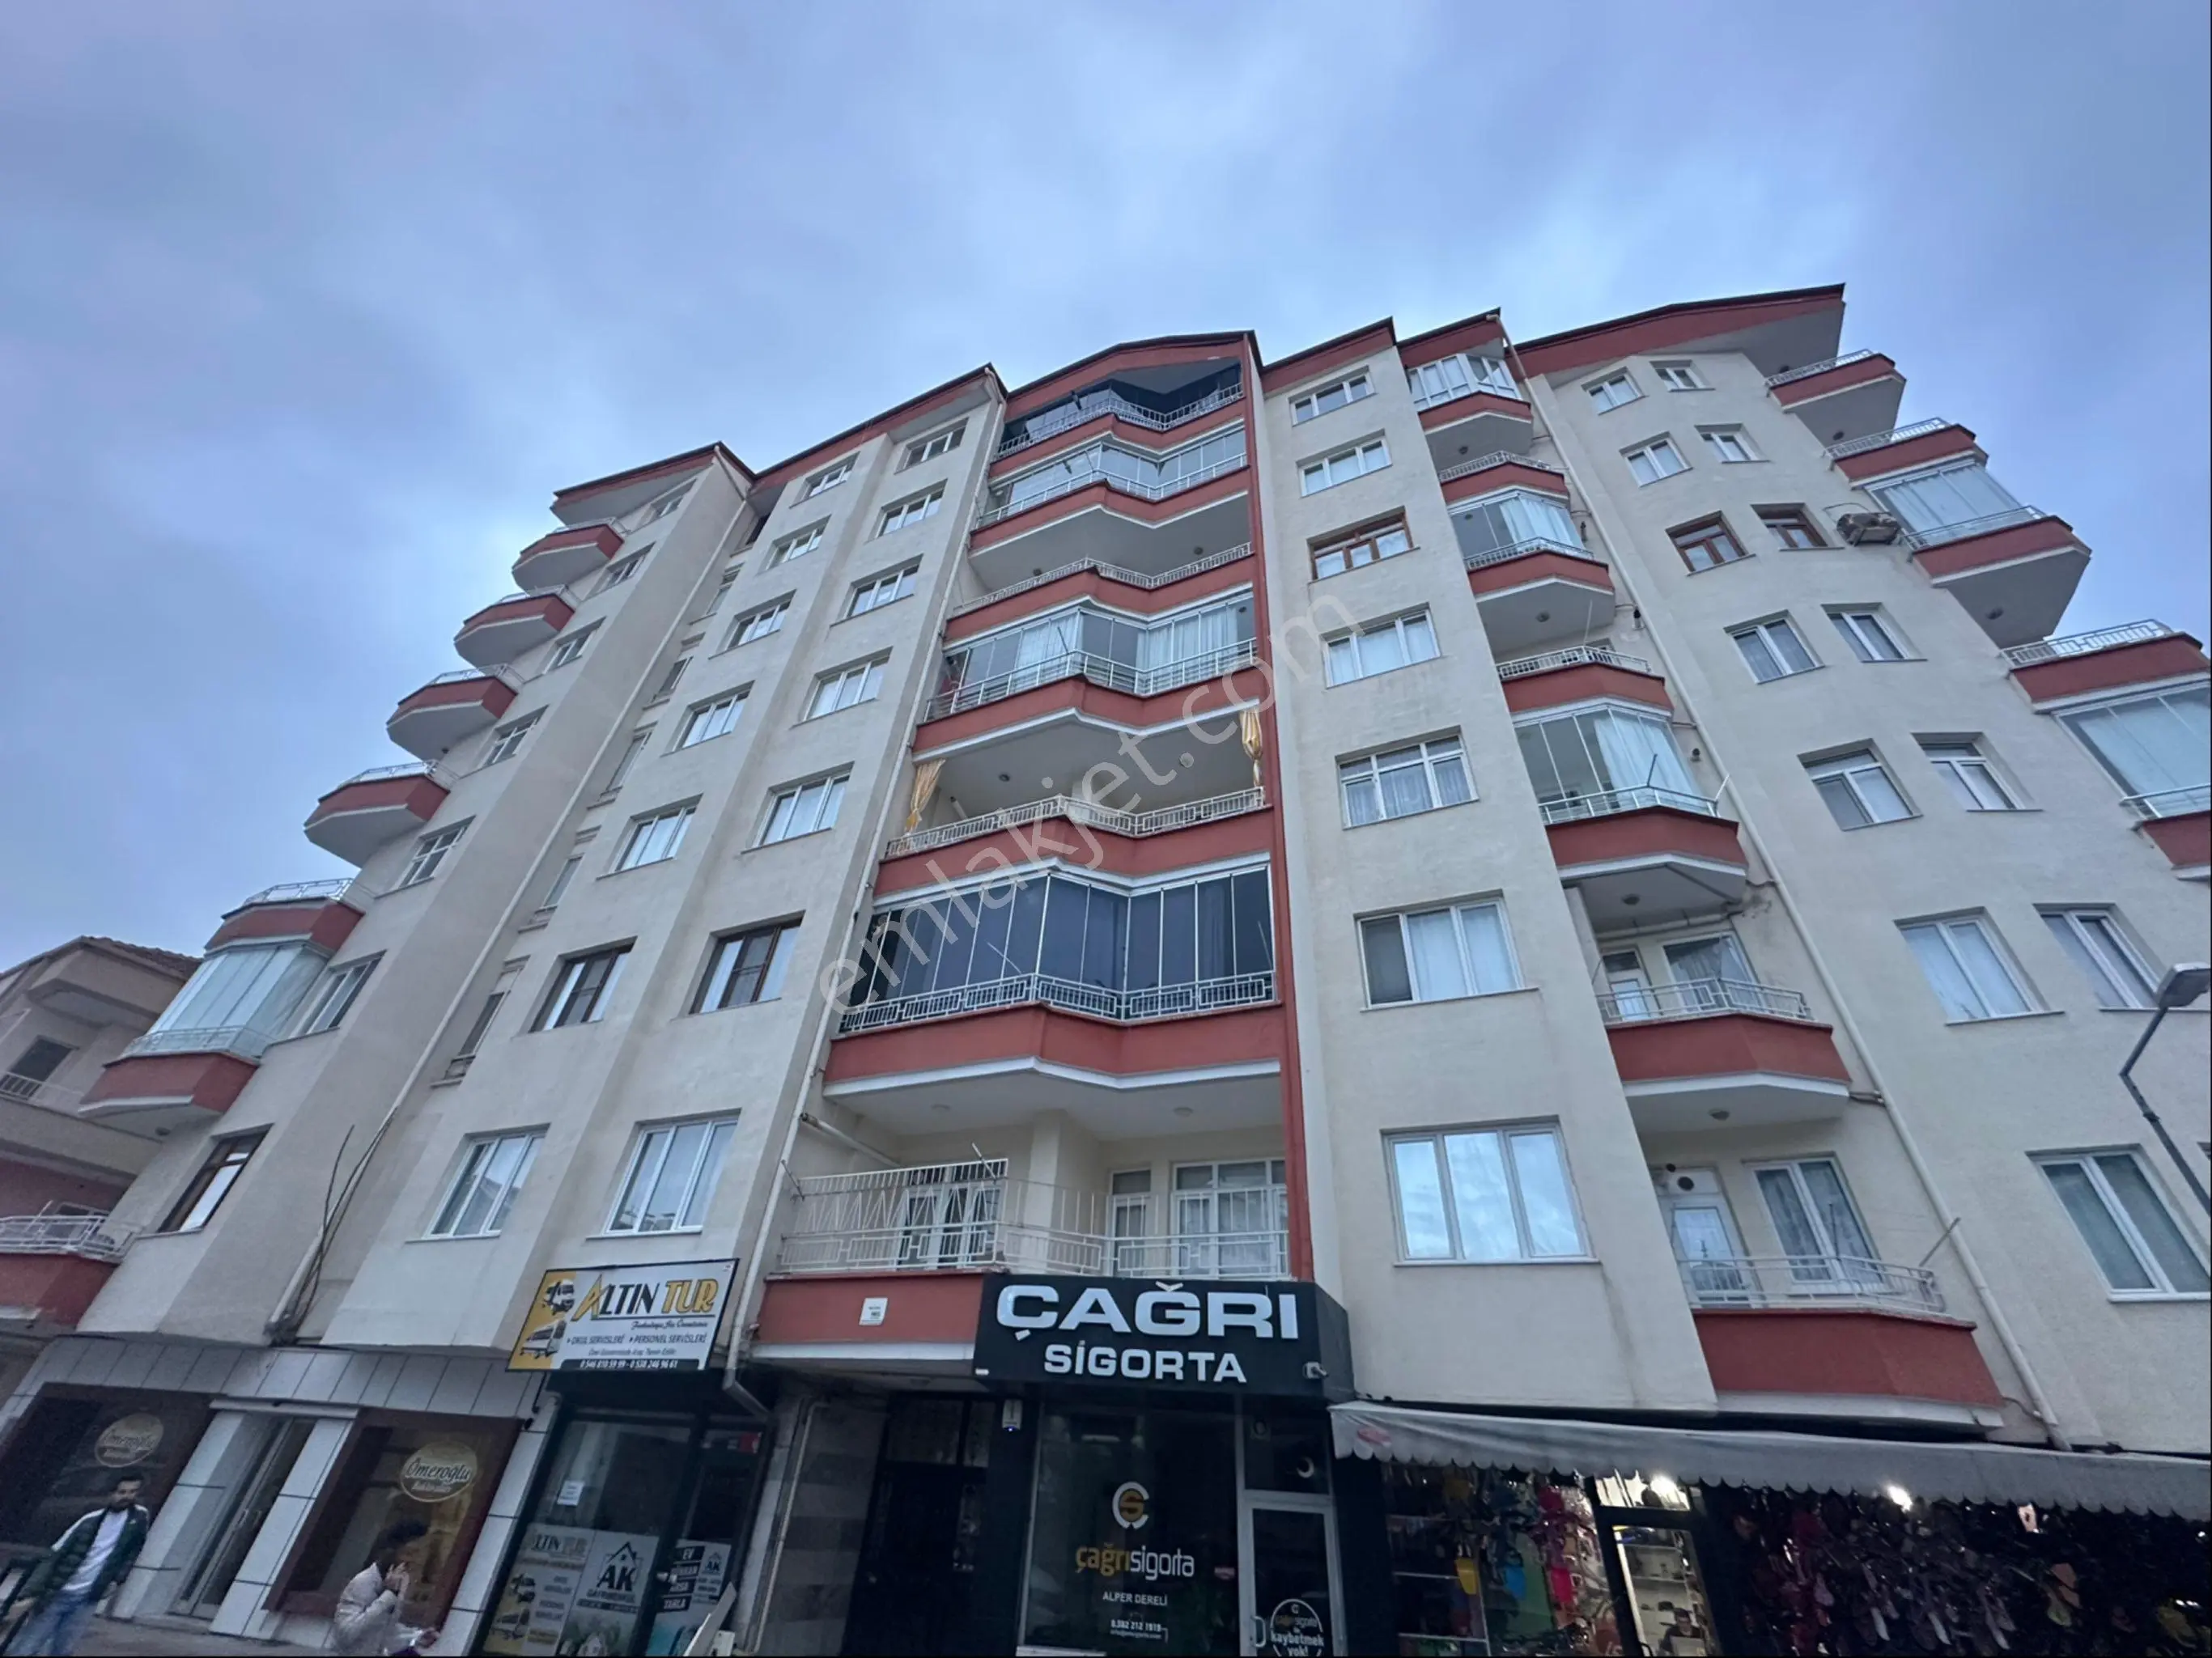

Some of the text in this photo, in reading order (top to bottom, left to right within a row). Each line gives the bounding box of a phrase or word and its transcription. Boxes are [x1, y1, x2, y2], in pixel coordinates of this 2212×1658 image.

[570, 1274, 719, 1322] ALTIN TUR
[996, 1281, 1299, 1341] ÇAĞRI
[1044, 1340, 1247, 1384] SİGORTA
[597, 1564, 637, 1592] AK
[1102, 1591, 1168, 1606] ALPER DERELİ
[1271, 1630, 1324, 1647] kaybetmek
